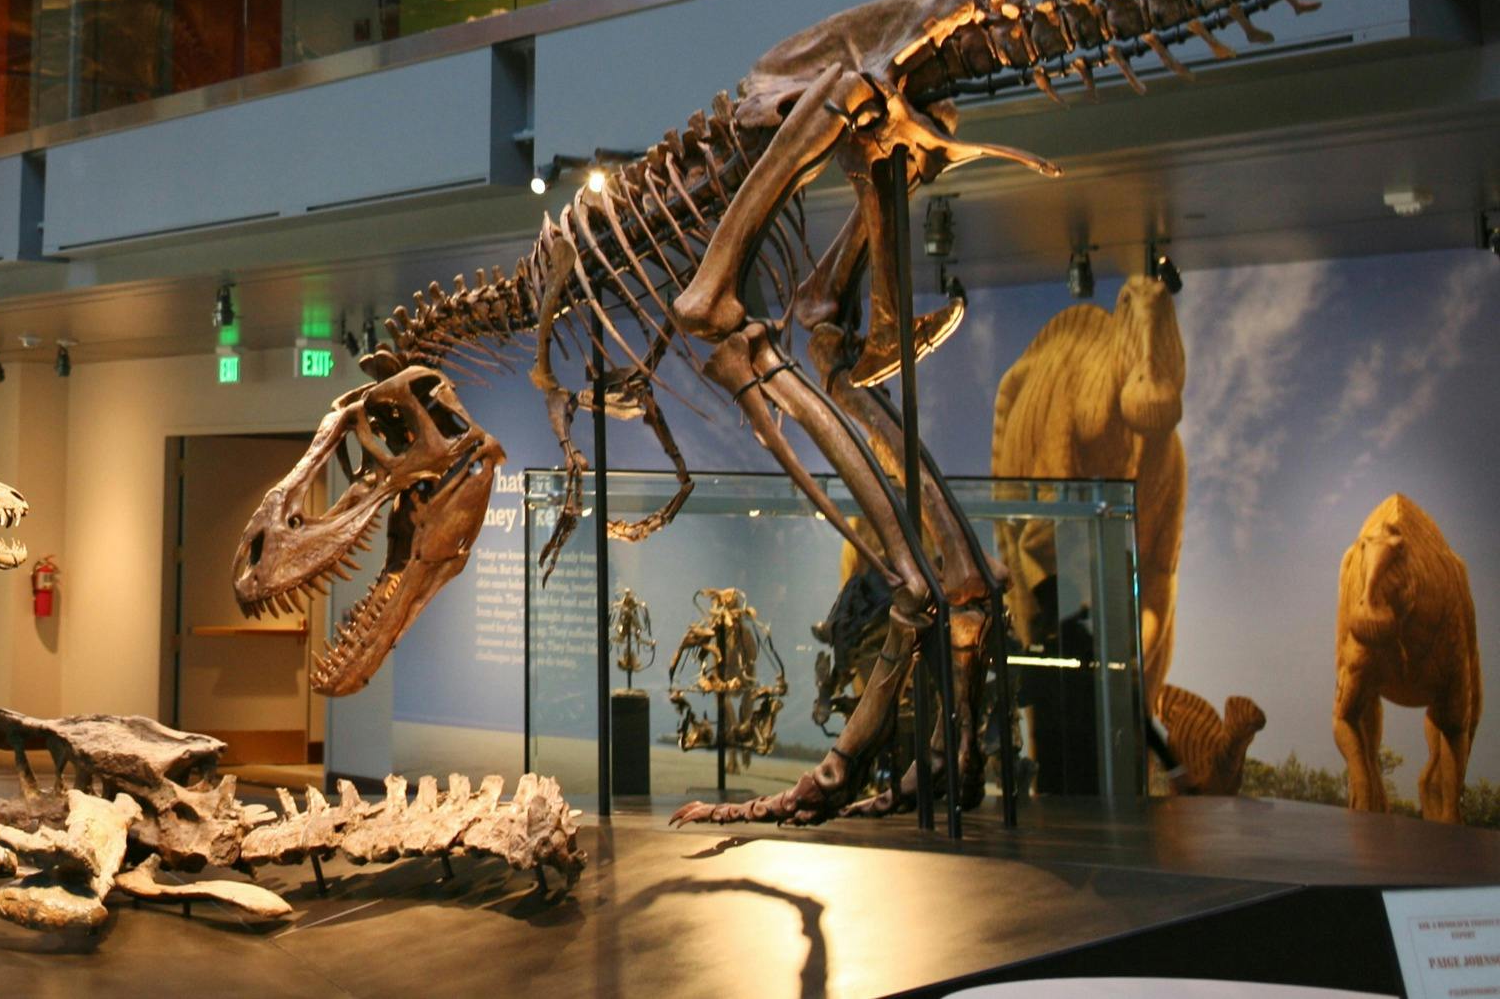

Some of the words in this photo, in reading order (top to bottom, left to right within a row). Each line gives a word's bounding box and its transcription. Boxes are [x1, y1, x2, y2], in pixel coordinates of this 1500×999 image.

[219, 356, 239, 383] EXIT
[302, 349, 332, 377] EXIT
[494, 466, 525, 493] hat
[484, 504, 517, 533] hey
